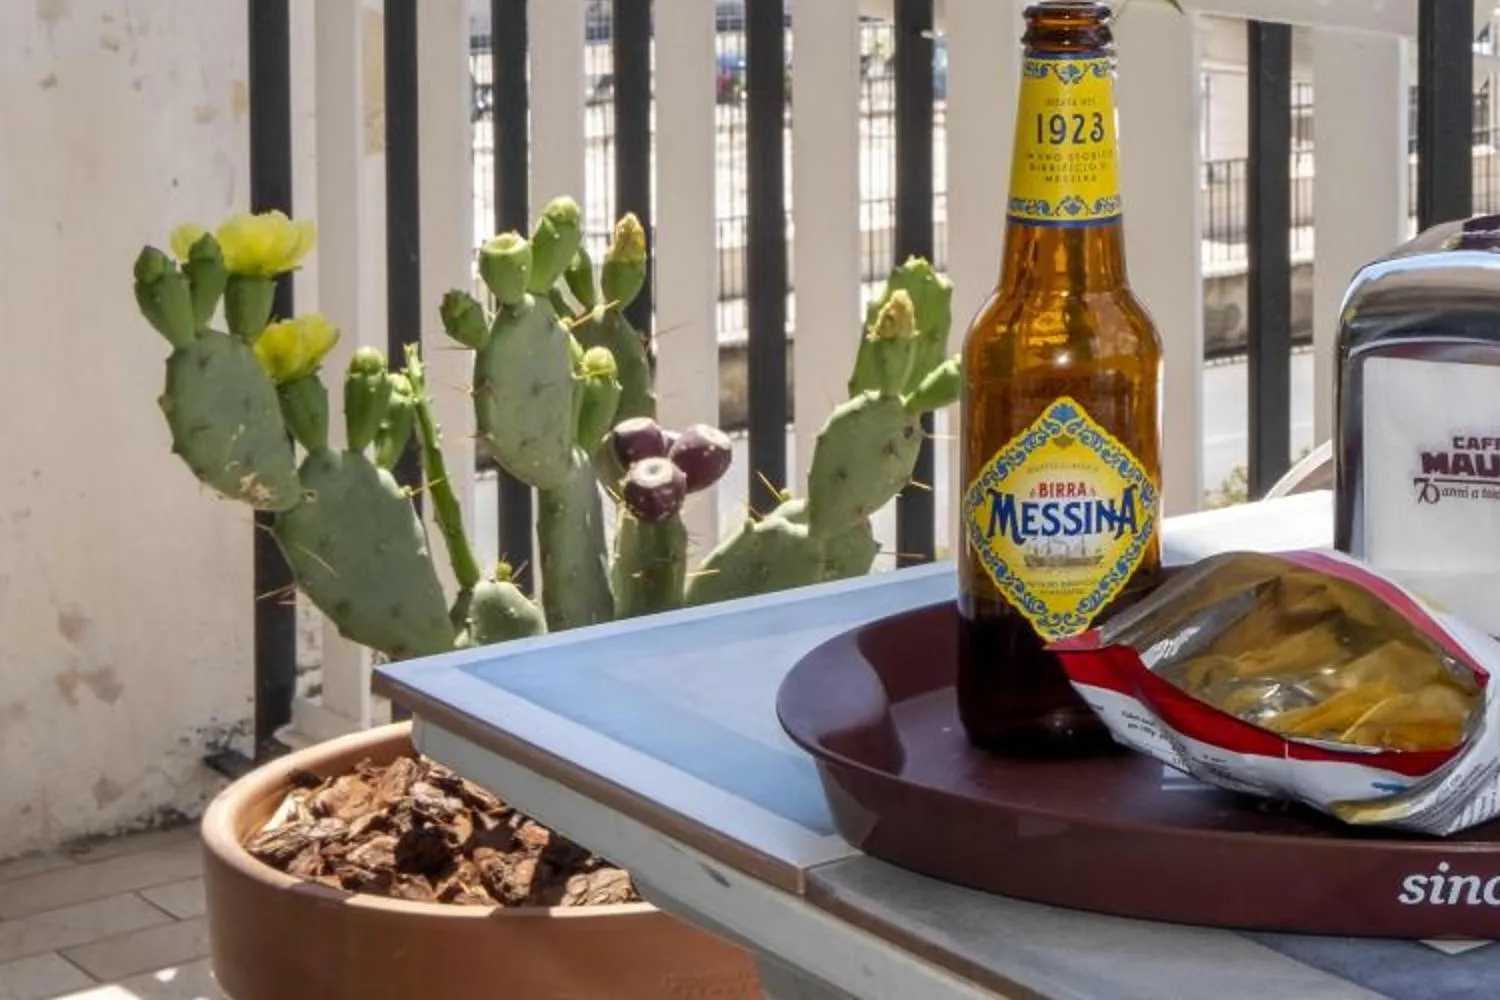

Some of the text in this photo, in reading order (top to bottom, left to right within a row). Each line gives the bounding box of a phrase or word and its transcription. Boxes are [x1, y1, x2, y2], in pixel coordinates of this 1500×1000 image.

[1036, 111, 1105, 145] 1923
[1038, 481, 1087, 498] BIRRA
[986, 483, 1138, 545] MESSINA
